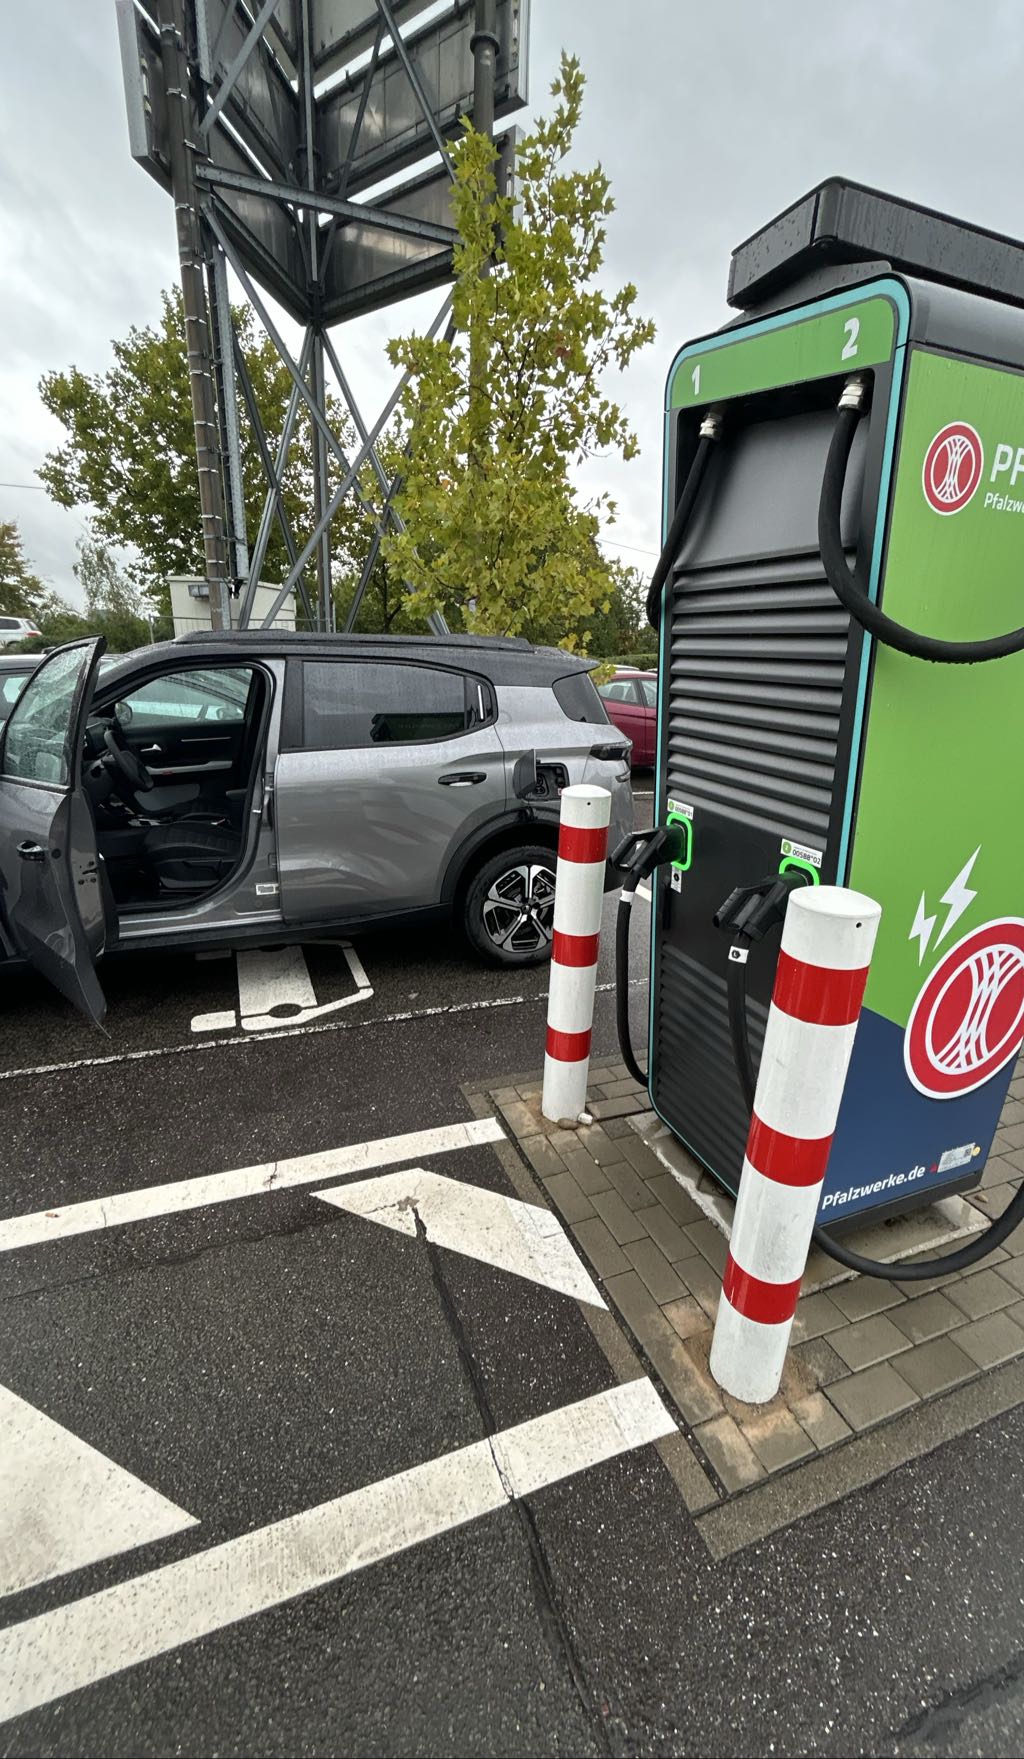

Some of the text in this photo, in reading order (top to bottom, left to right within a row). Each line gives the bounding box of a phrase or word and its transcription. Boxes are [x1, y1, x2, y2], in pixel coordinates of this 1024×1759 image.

[841, 317, 860, 361] 2
[691, 364, 701, 396] 1
[821, 1165, 926, 1211] Pfalzwerke.de
